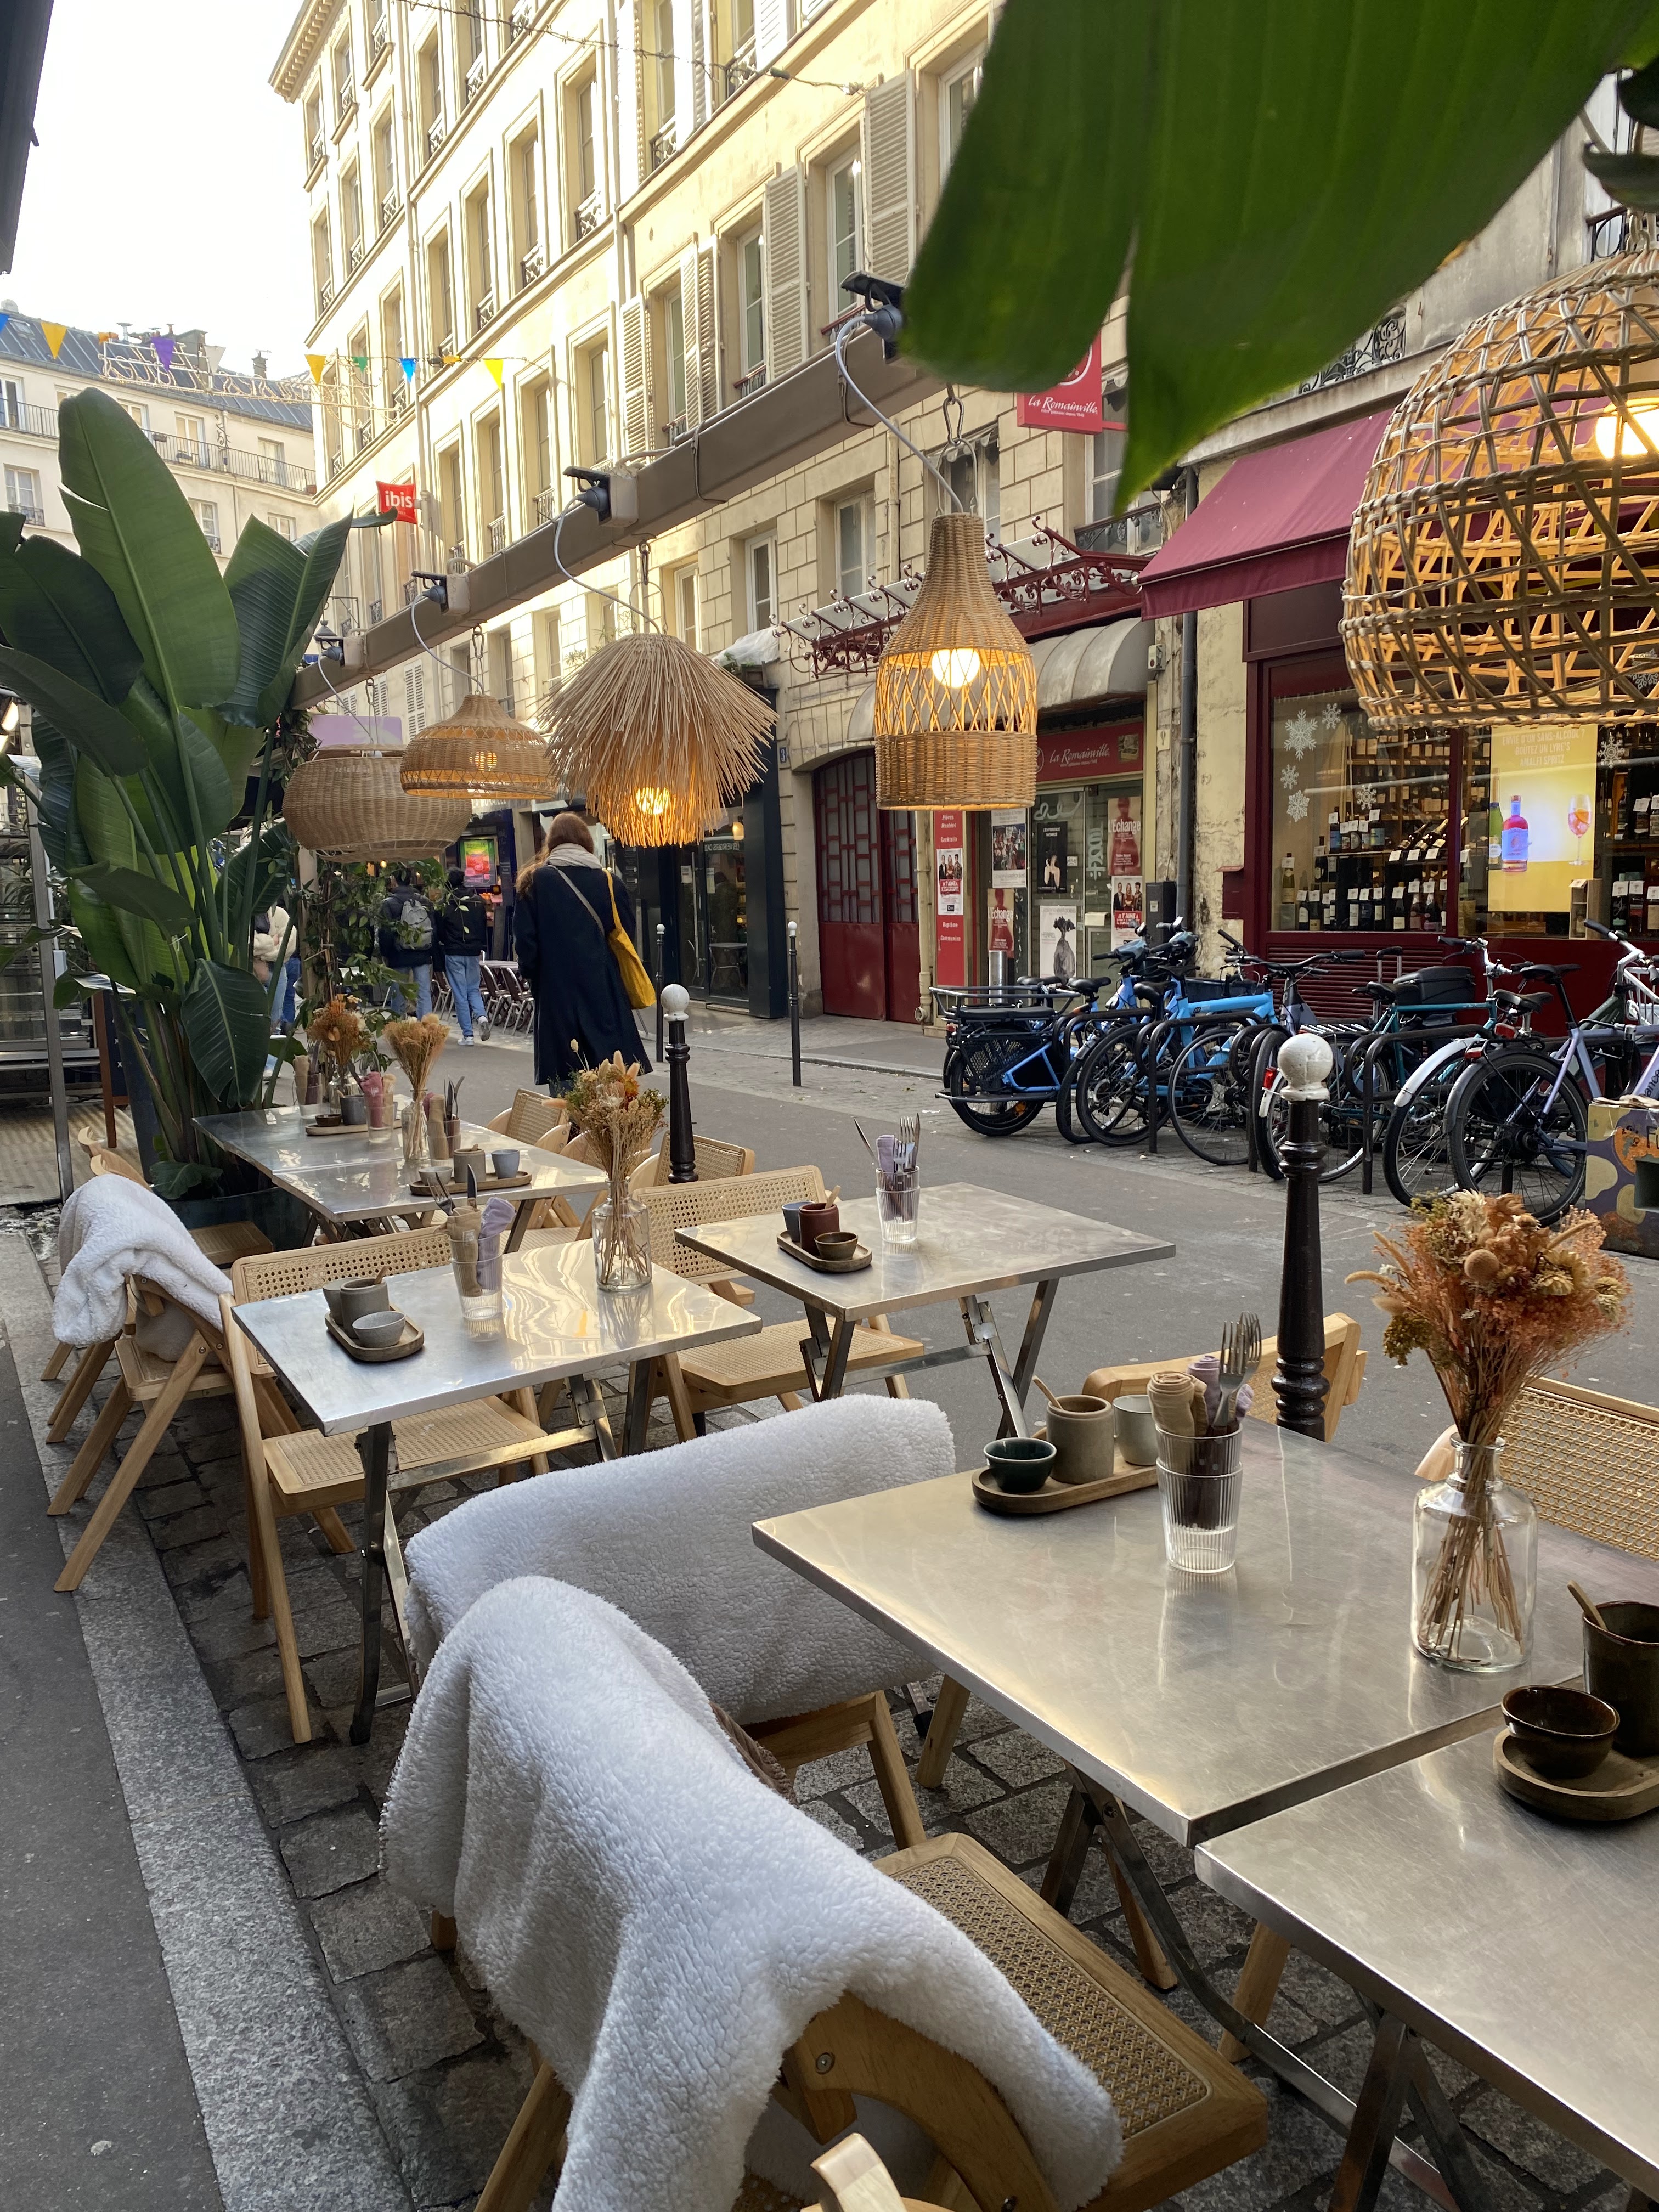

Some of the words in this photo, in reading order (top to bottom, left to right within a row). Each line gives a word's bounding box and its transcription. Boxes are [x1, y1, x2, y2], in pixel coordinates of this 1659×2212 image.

[1028, 395, 1041, 407] La
[1042, 397, 1097, 414] Romainville
[385, 490, 413, 508] ibis
[1502, 736, 1519, 746] ENVIE
[1521, 734, 1536, 743] D'UN
[1537, 729, 1579, 742] SANS-ALCOOL
[781, 749, 786, 762] 3
[1049, 750, 1060, 764] La
[1061, 743, 1110, 764] Romainville
[1539, 744, 1548, 753] UN
[1550, 742, 1570, 753] LYRE'S
[1520, 758, 1542, 767] AMALFI
[1544, 755, 1565, 765] SPRITZ
